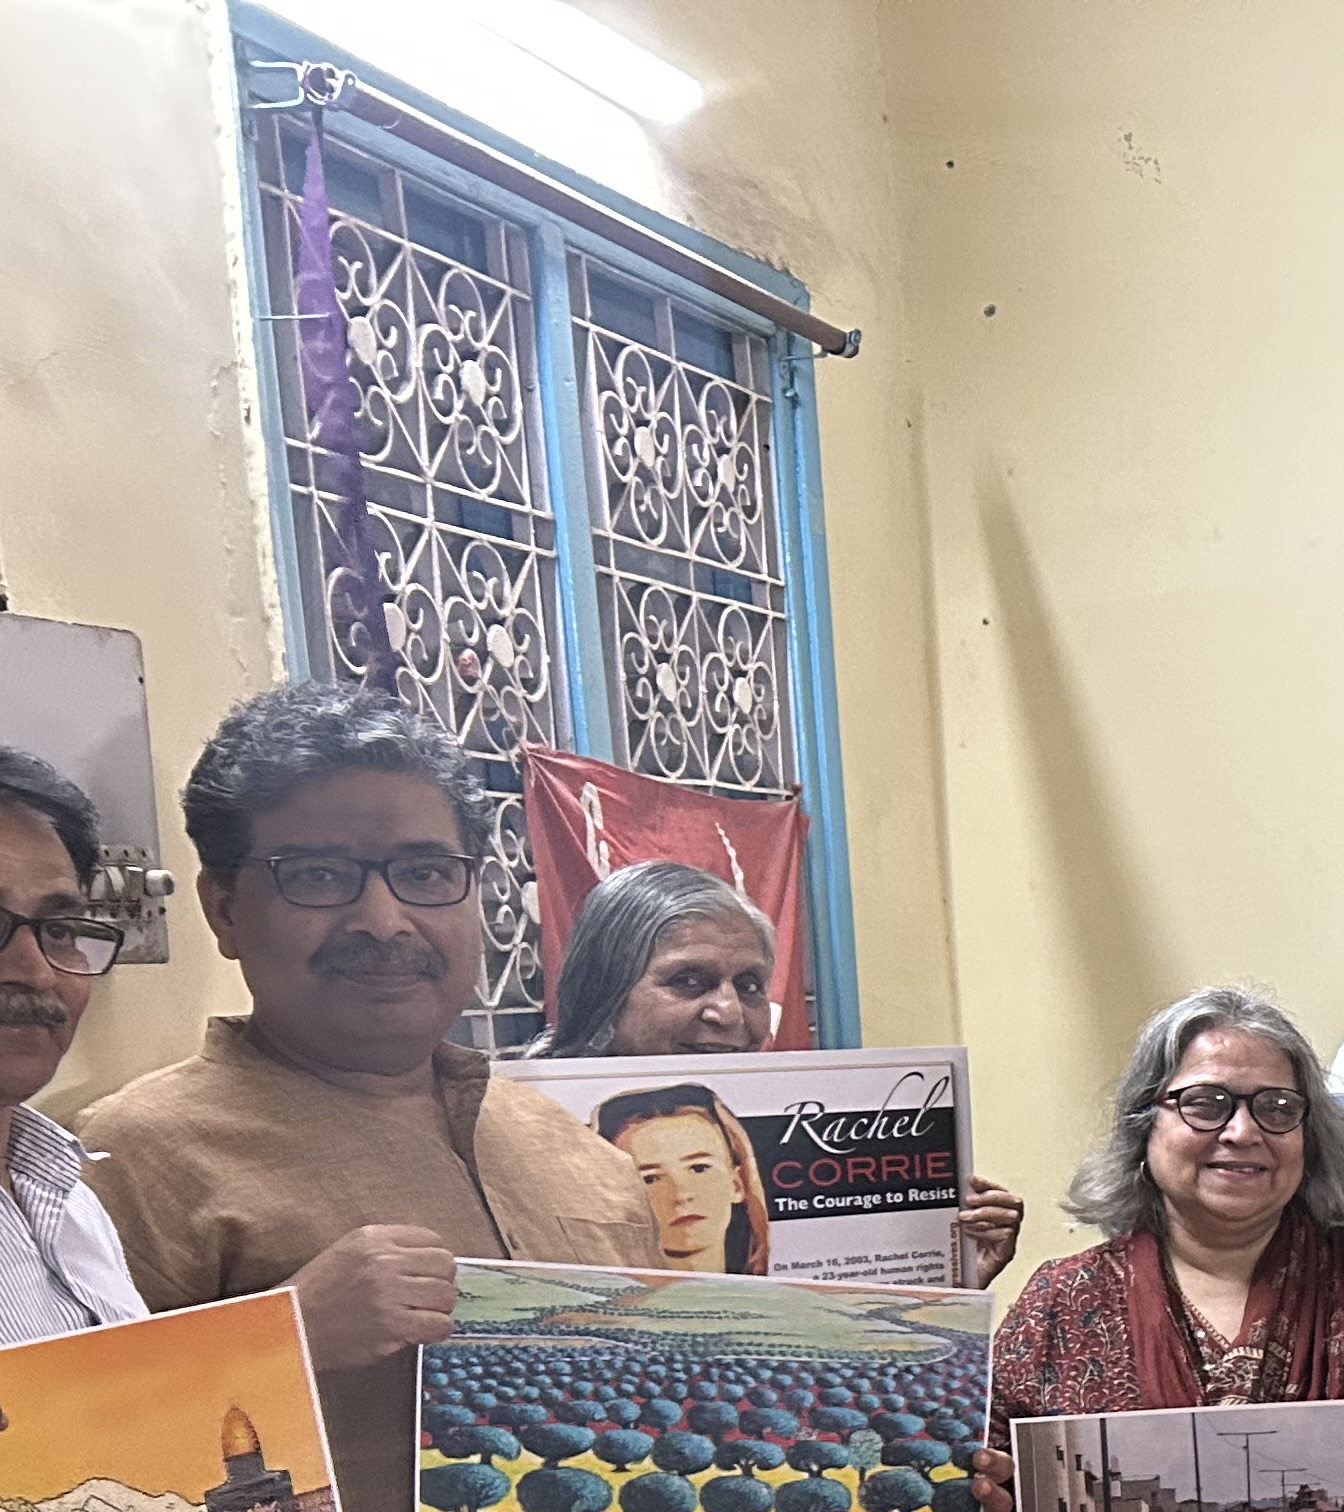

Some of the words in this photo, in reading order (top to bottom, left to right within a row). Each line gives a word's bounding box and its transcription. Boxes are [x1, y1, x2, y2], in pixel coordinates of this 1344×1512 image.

[780, 1071, 950, 1154] Rachel
[771, 1151, 954, 1190] CORRIE
[775, 1196, 810, 1212] The
[812, 1191, 882, 1212] Courage
[886, 1189, 904, 1204] to
[908, 1186, 957, 1202] Resist
[773, 1262, 788, 1271] On
[791, 1260, 823, 1270] March
[875, 1252, 908, 1262] Rachel
[911, 1250, 945, 1259] Corrie,
[822, 1267, 878, 1281] 23-year-old
[880, 1265, 914, 1275] human
[916, 1262, 945, 1273] rights
[927, 1275, 945, 1283] and
